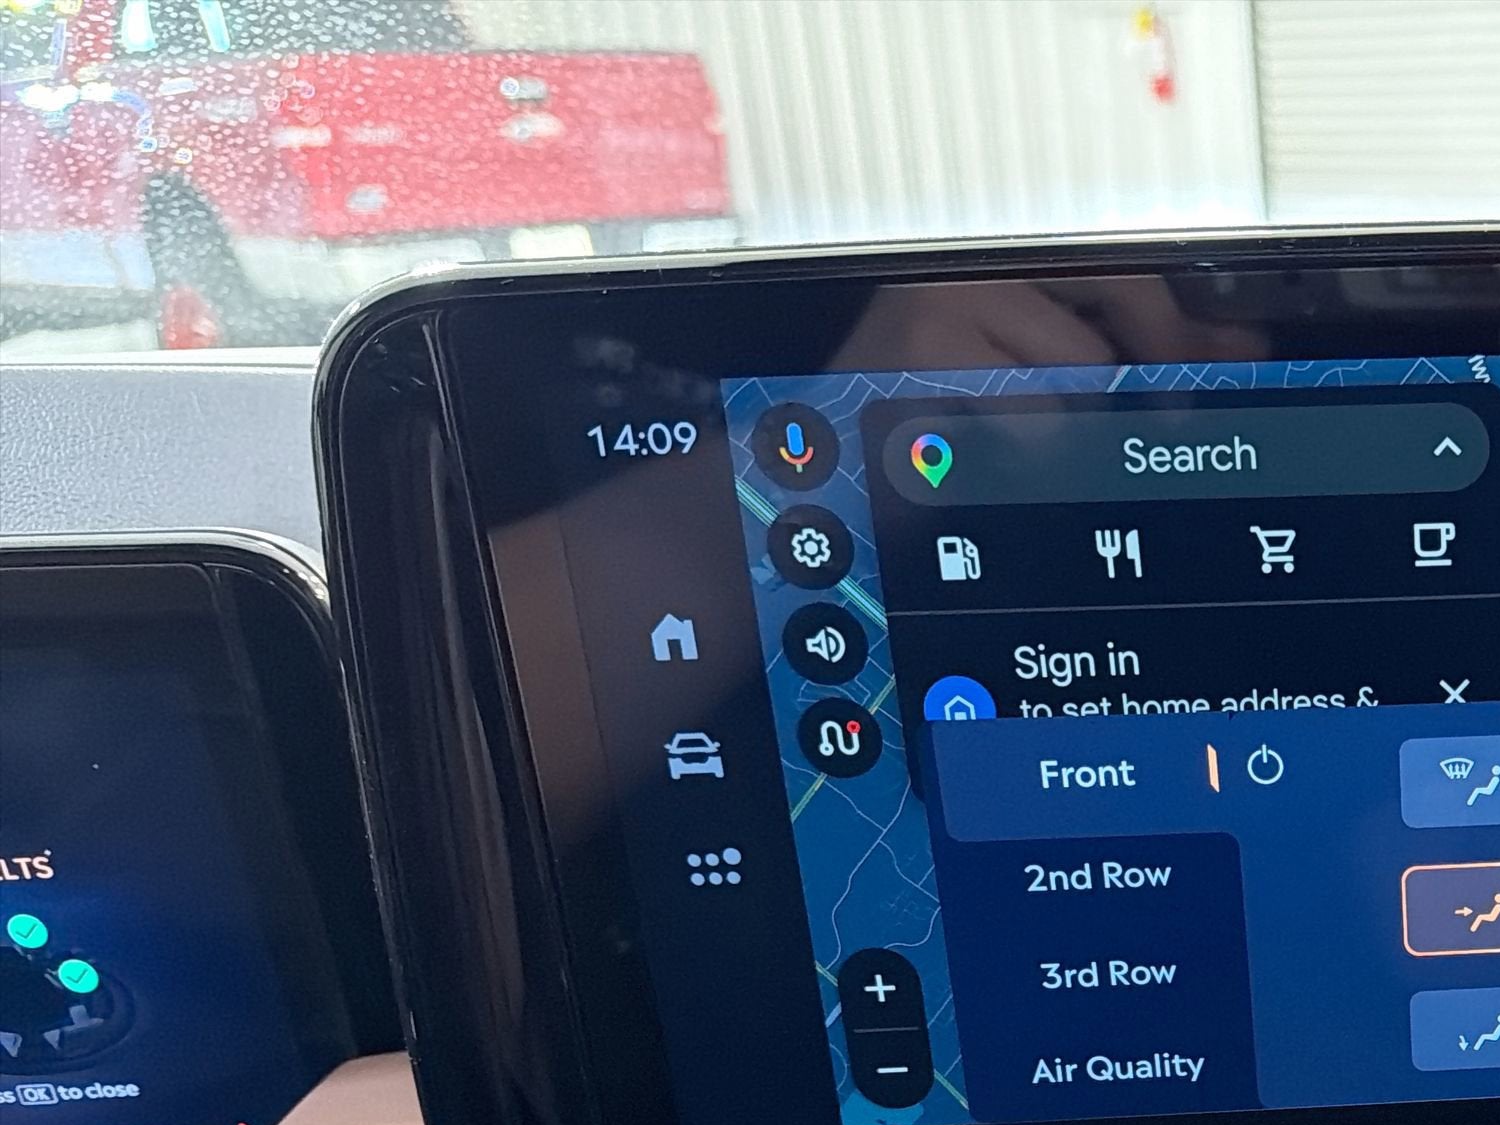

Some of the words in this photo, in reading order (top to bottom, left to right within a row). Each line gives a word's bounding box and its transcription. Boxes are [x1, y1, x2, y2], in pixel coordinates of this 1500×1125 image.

[587, 421, 697, 457] 14:09
[1123, 435, 1257, 474] Search
[1014, 643, 1096, 687] Sign
[1106, 641, 1140, 676] in
[1019, 699, 1052, 718] to
[1062, 697, 1112, 718] set
[1121, 692, 1211, 716] home
[1221, 687, 1346, 712] address
[1040, 760, 1136, 789] Front
[0, 856, 54, 880] LTS
[1024, 862, 1093, 892] 2nd
[1102, 861, 1172, 889] Row
[1040, 961, 1099, 989] 3rd
[1108, 960, 1177, 986] Row
[1032, 1057, 1078, 1084] Air
[1086, 1052, 1205, 1082] Quality
[24, 1087, 51, 1102] OK
[57, 1085, 83, 1100] to
[85, 1082, 140, 1099] close
